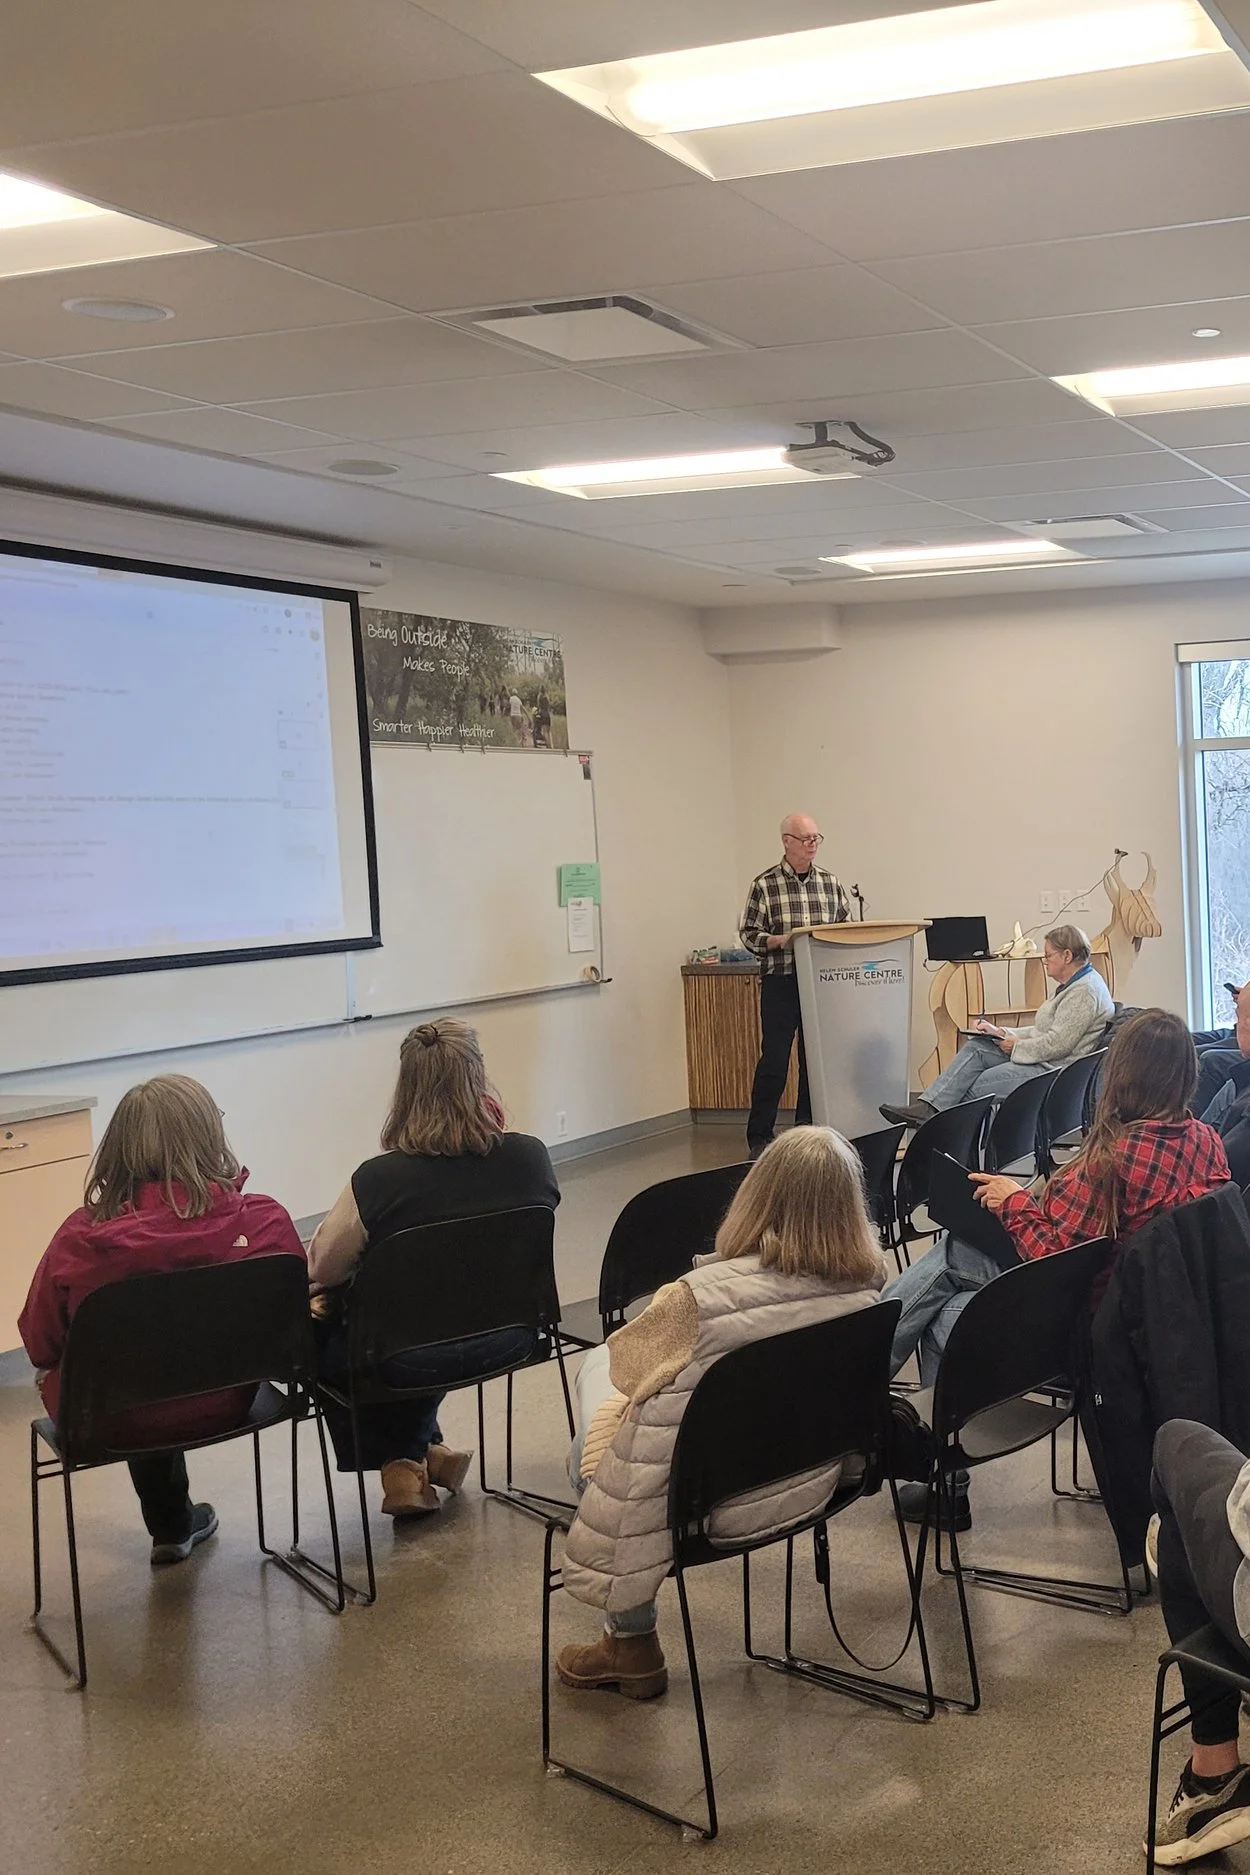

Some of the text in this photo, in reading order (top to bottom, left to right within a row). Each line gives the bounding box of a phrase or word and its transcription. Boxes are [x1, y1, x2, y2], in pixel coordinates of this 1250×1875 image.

[367, 625, 448, 649] Being Outside
[403, 656, 470, 681] Makes People
[372, 718, 495, 741] Smarter Happier Healthier
[819, 969, 903, 982] NATURE CENTRE
